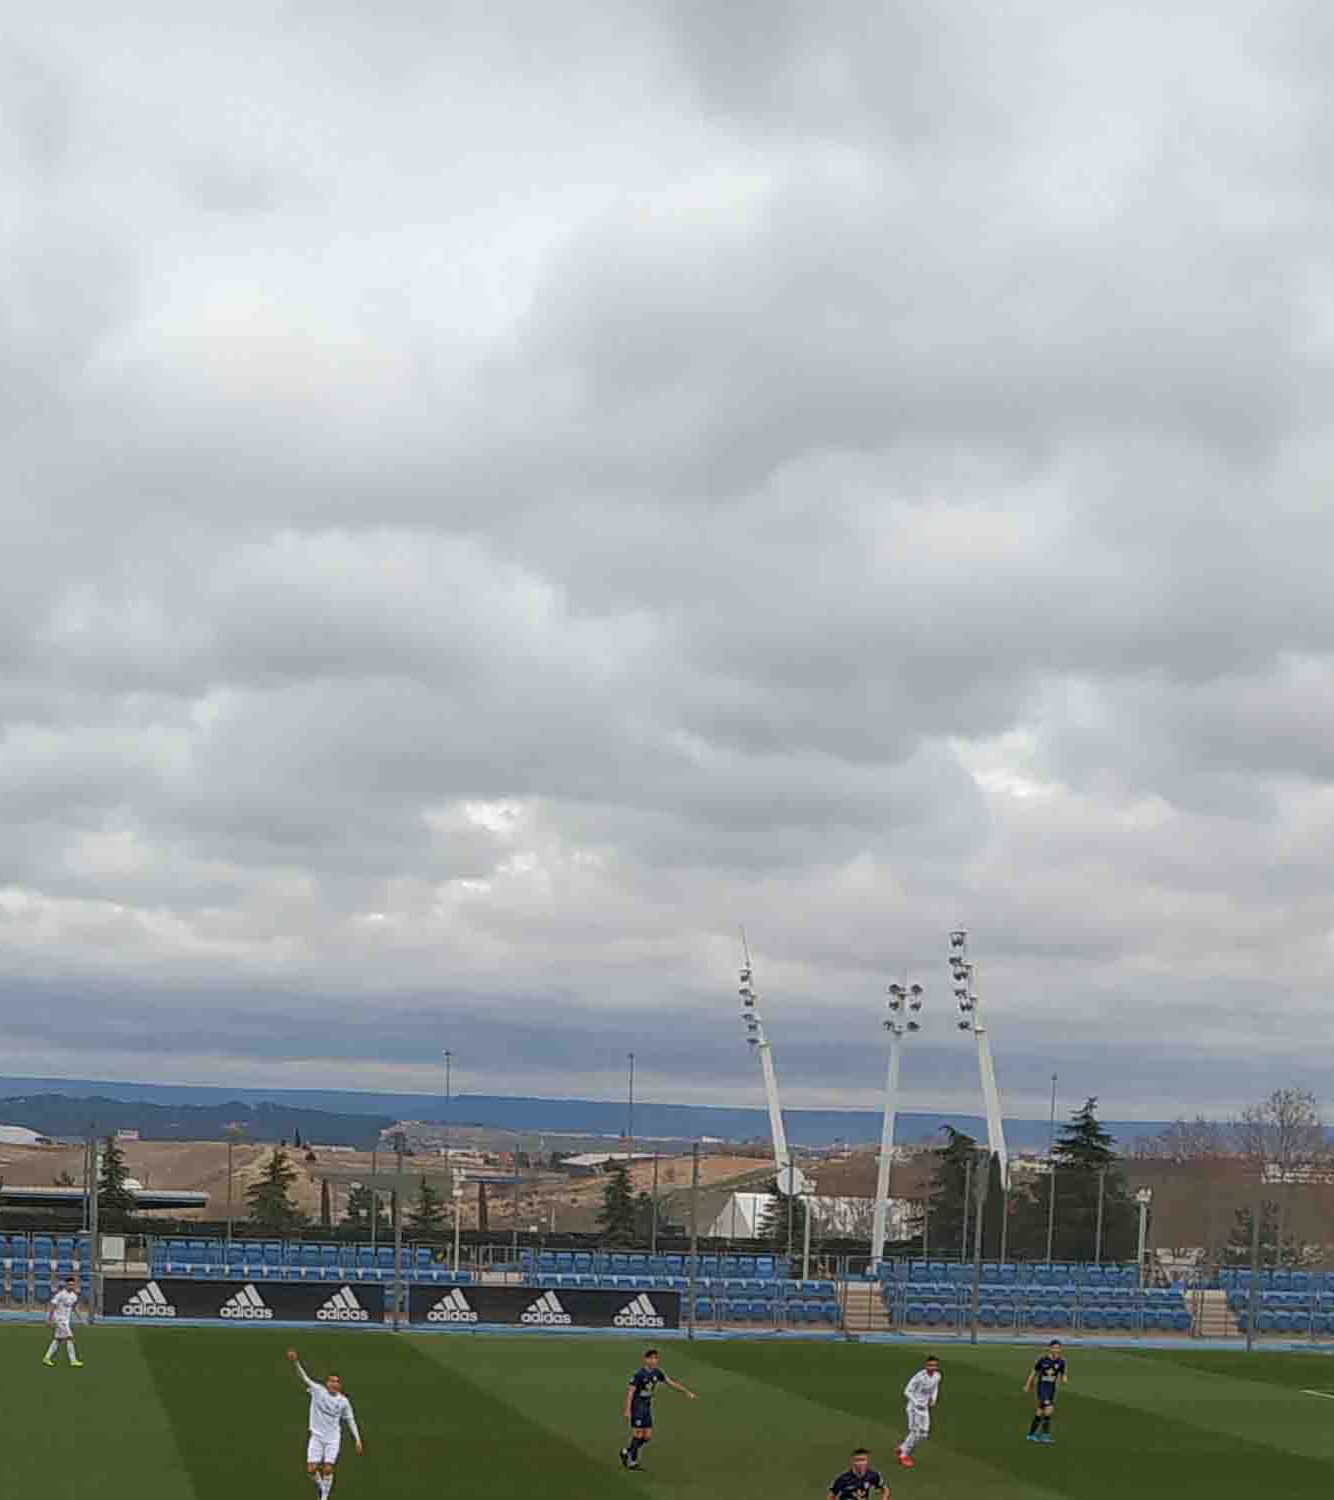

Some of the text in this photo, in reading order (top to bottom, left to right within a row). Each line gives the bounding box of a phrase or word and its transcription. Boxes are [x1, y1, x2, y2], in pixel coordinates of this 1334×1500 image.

[122, 1303, 175, 1317] adidas
[220, 1306, 273, 1319] adidas
[317, 1308, 368, 1321] adidas
[427, 1310, 478, 1322] adidas
[521, 1313, 571, 1325] adidas
[613, 1315, 665, 1328] adidas
